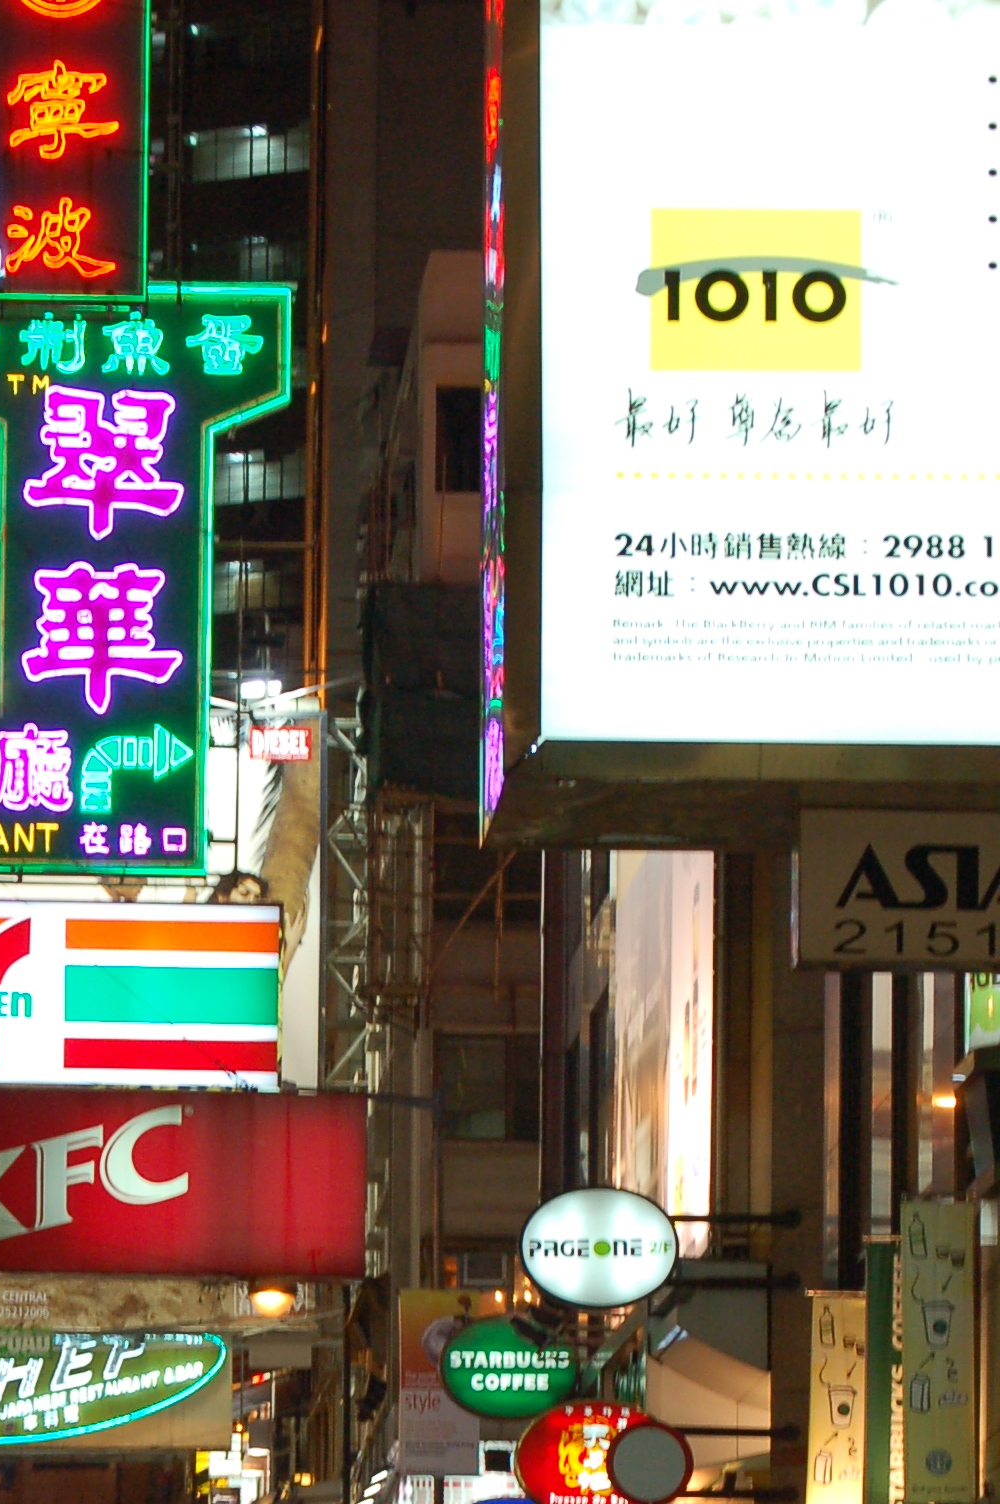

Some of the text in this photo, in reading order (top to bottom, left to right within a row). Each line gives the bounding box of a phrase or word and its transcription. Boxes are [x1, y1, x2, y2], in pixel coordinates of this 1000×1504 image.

[664, 268, 847, 323] 1010
[21, 385, 184, 714] 翠華
[883, 533, 966, 560] 2988
[252, 729, 309, 755] DIESEL
[836, 842, 1000, 912] ASI
[2, 1291, 48, 1304] CENTRAL
[449, 1350, 570, 1370] STARBUCKS
[470, 1372, 549, 1392] COFFEE
[405, 1392, 442, 1415] style
